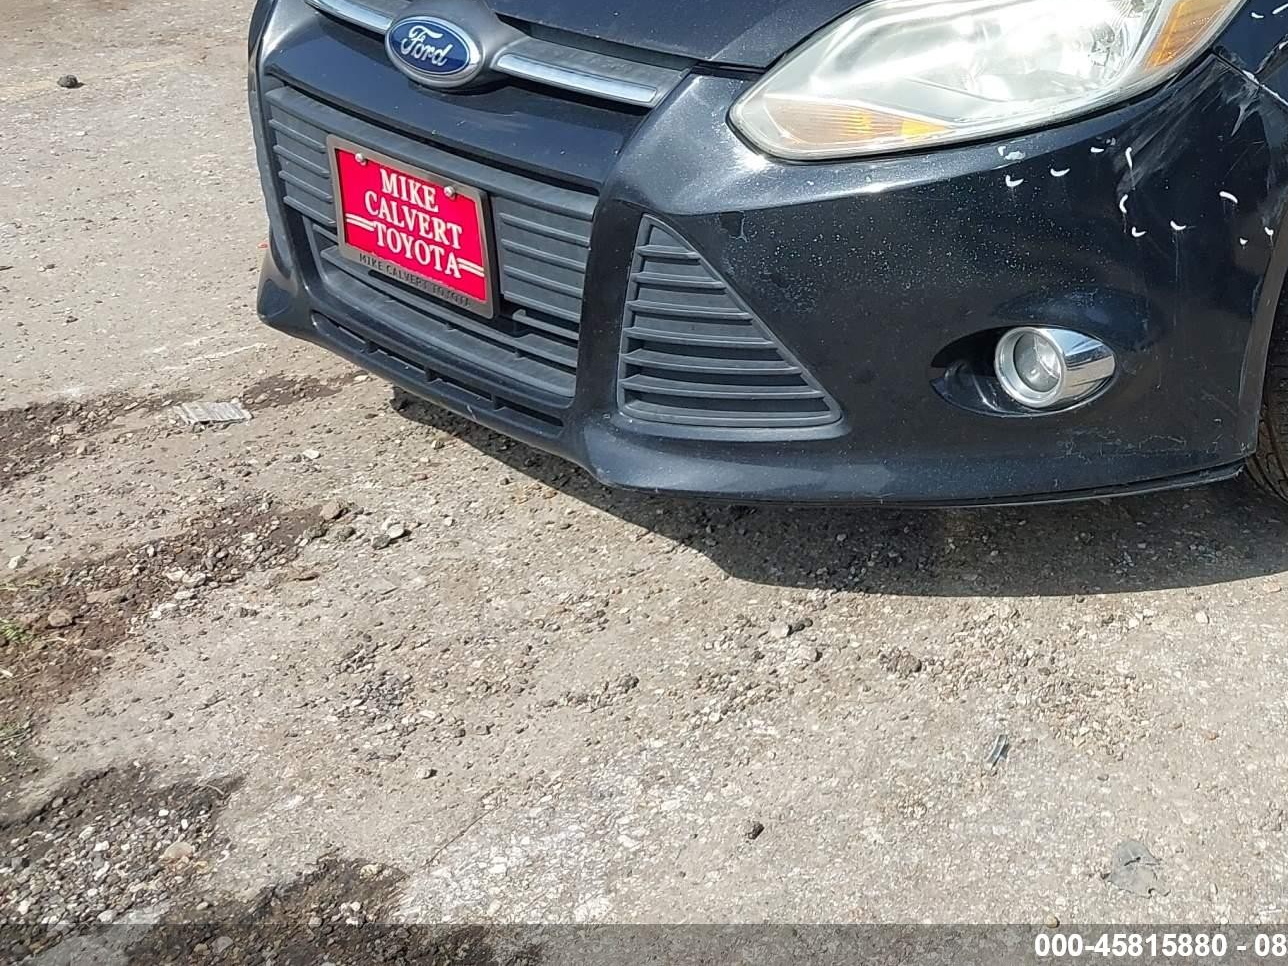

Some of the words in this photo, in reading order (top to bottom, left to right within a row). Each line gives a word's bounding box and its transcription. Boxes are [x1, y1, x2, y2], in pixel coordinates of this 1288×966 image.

[401, 25, 453, 66] Ford
[380, 168, 438, 212] MIKE
[365, 190, 462, 249] CALVERT
[360, 253, 382, 271] MIKE
[372, 220, 461, 278] TOYOTA
